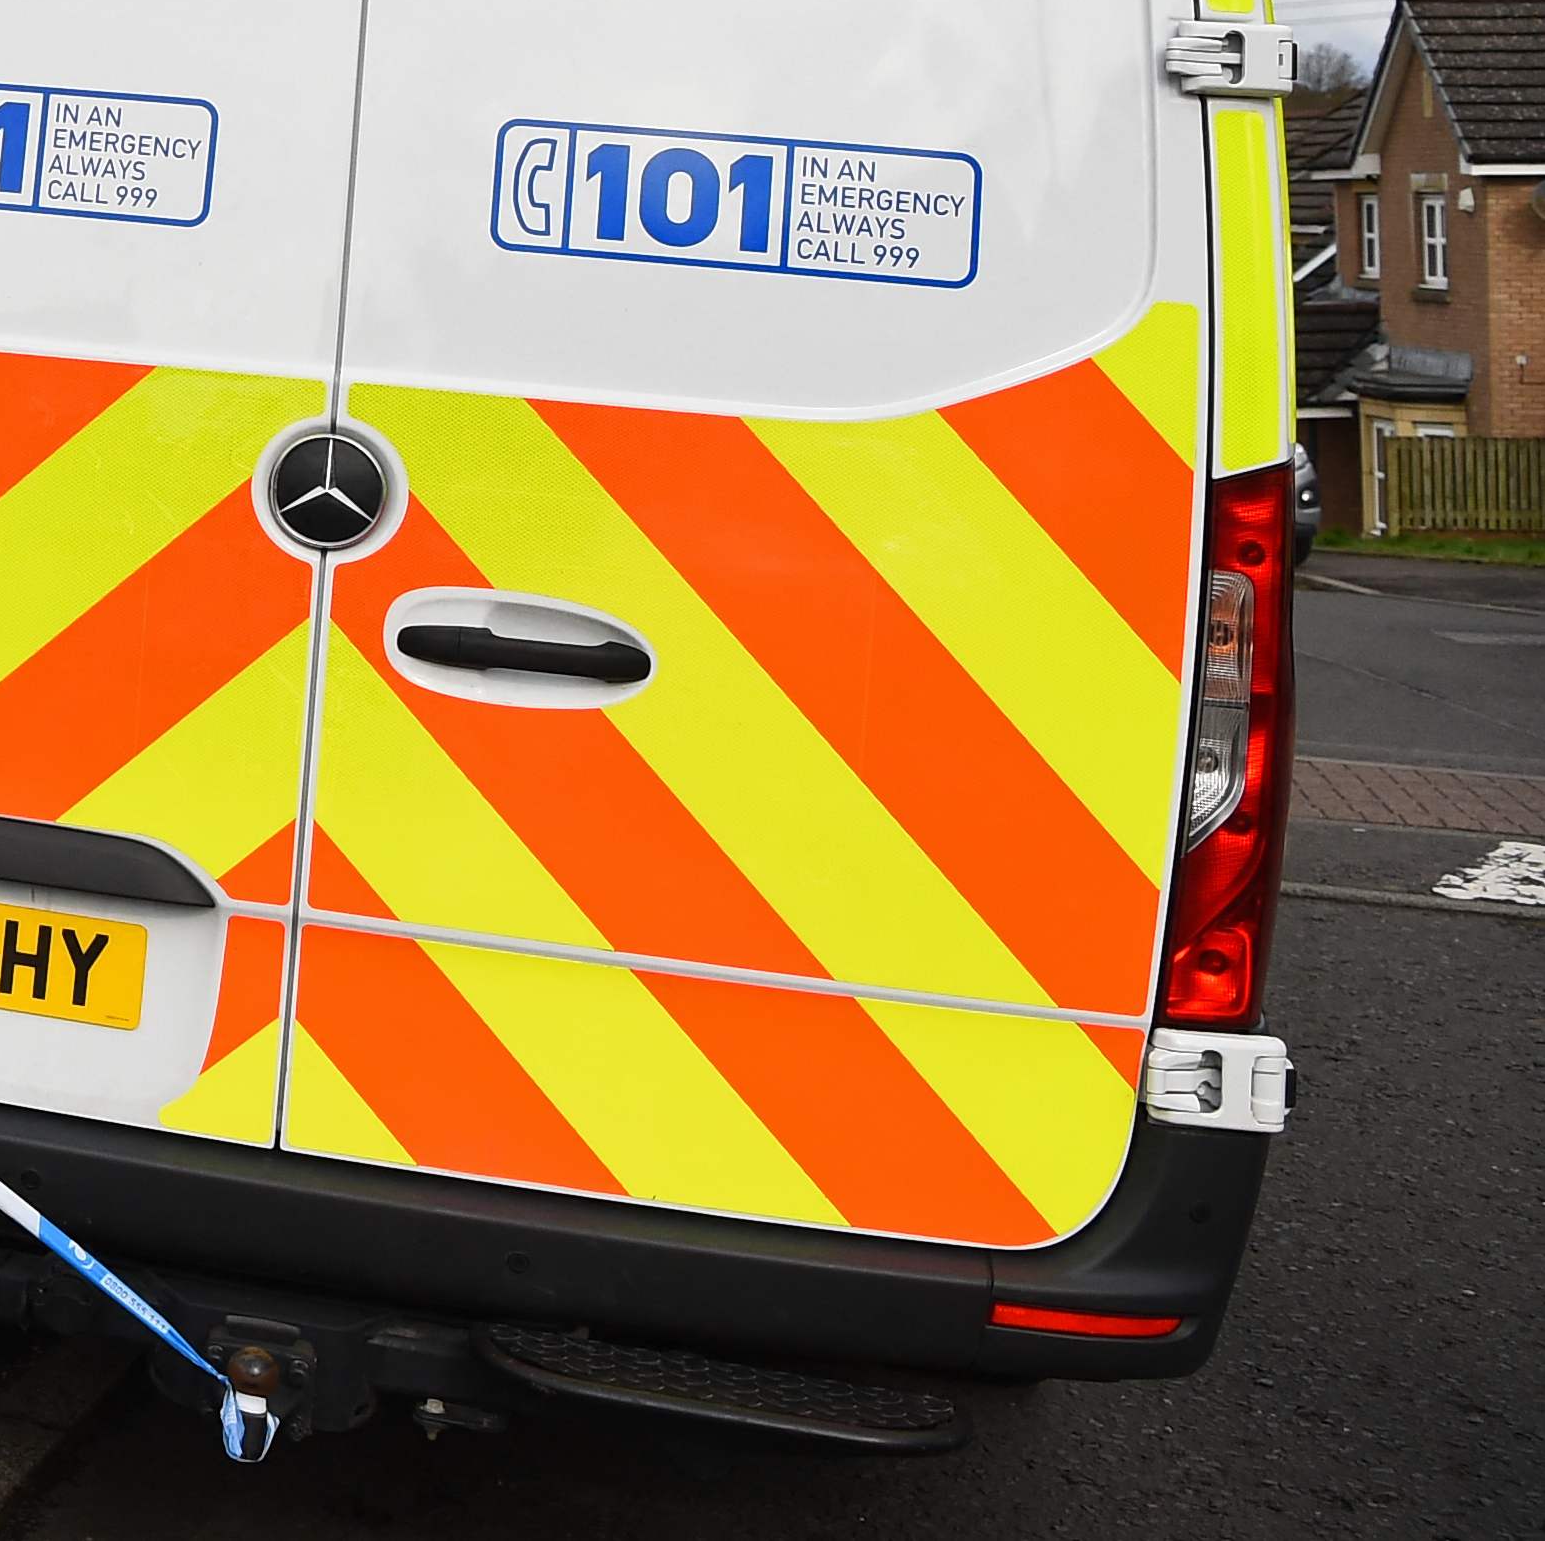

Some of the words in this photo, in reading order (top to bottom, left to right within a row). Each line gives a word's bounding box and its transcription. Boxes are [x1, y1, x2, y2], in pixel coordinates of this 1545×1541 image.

[55, 103, 79, 125] IN
[86, 105, 122, 128] AN
[52, 128, 202, 160] EMERGENCY
[48, 153, 146, 181] ALWAYS
[801, 155, 829, 179] IN
[837, 159, 876, 183] AN
[47, 180, 108, 205] CALL
[115, 185, 158, 209] 999
[586, 143, 773, 253] 101
[800, 183, 966, 218] EMERGENCY
[796, 210, 906, 240] ALWAYS
[796, 238, 865, 265] CALL
[873, 244, 920, 269] 999
